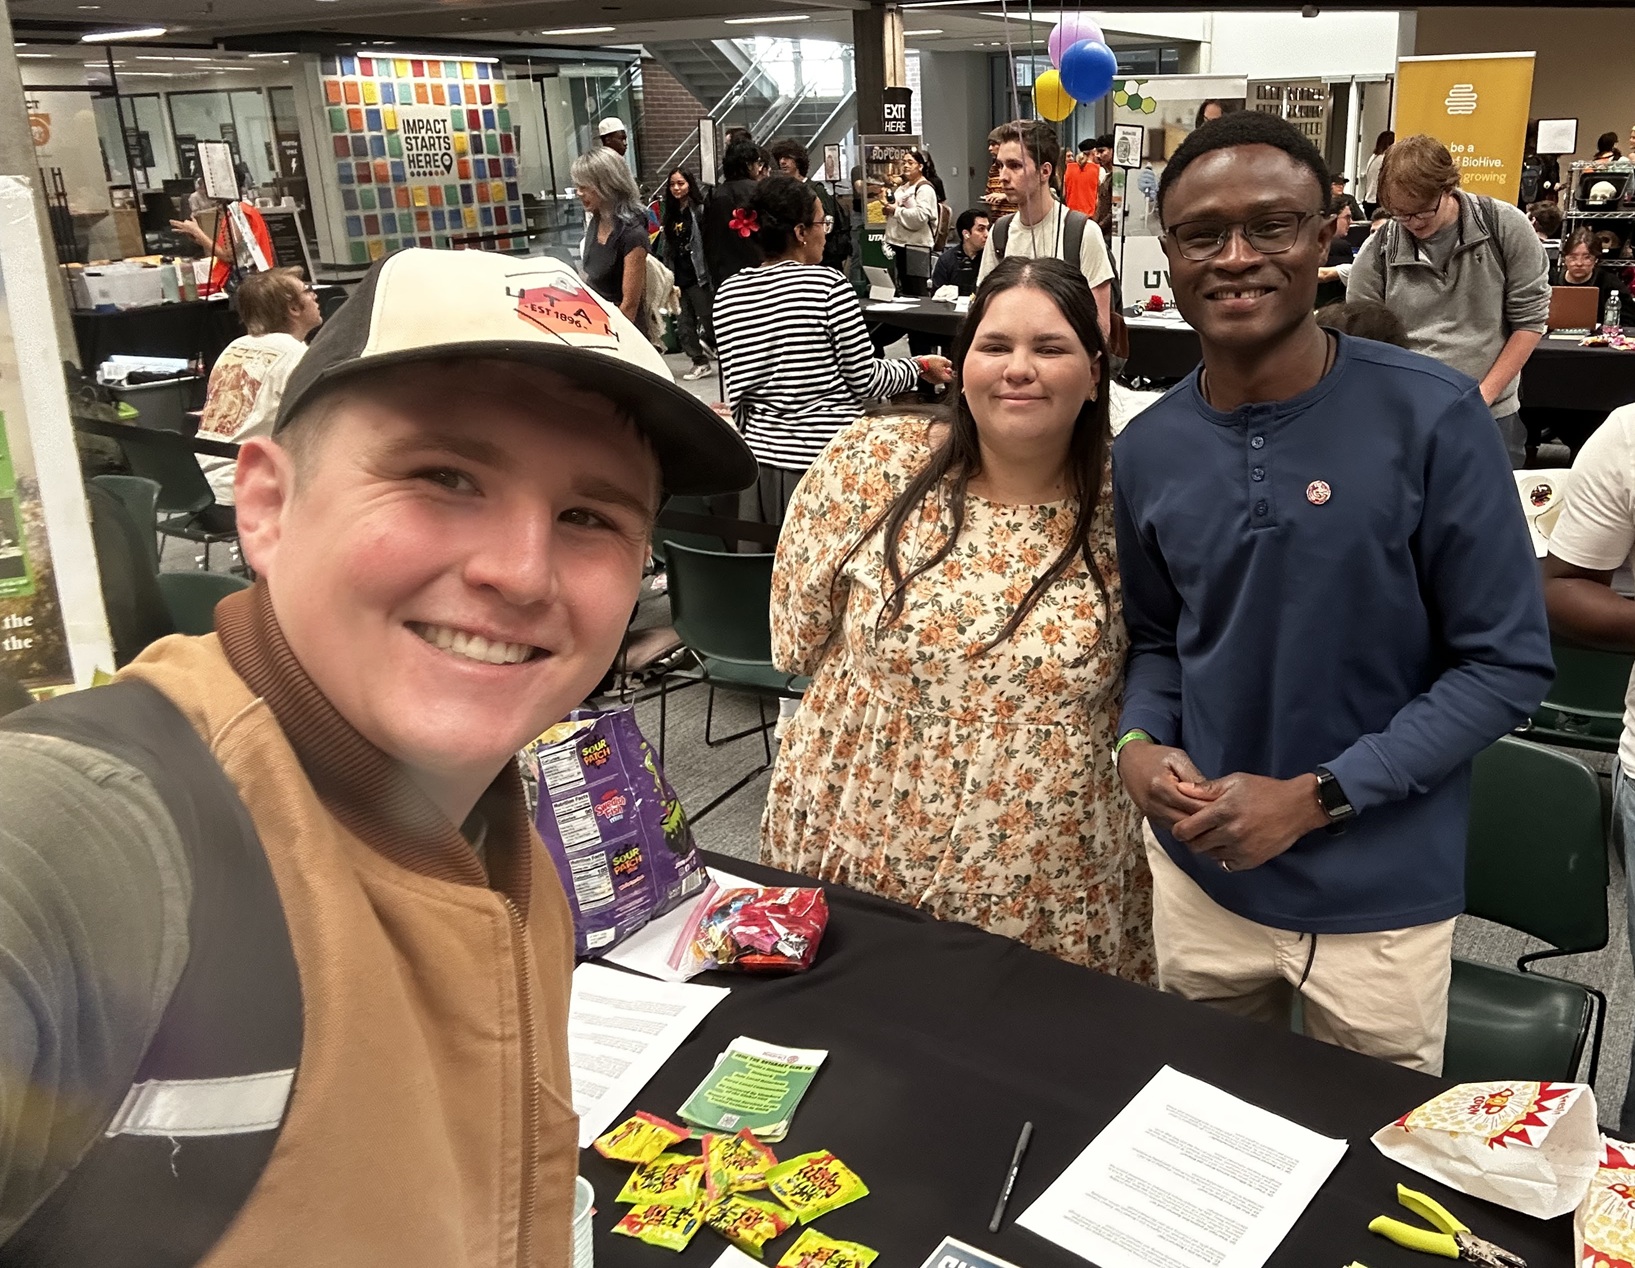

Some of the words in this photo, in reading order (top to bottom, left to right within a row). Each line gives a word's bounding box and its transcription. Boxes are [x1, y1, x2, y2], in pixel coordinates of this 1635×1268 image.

[884, 104, 906, 118] EXIT
[402, 119, 447, 134] IMPACT
[884, 121, 906, 132] HERE
[405, 136, 451, 151] STARTS
[1451, 142, 1464, 152] be
[407, 153, 441, 169] HERE
[872, 148, 909, 160] POPCOR
[1462, 157, 1504, 167] BioHive.
[1463, 171, 1507, 184] growing
[530, 303, 551, 316] EST
[554, 311, 582, 328] 1896
[4, 613, 34, 629] the
[3, 635, 33, 651] the
[582, 739, 607, 755] SOUR
[583, 747, 611, 766] PATCH
[594, 796, 627, 816] Swedish
[605, 807, 624, 819] Fish
[612, 847, 640, 866] SOUR
[613, 855, 643, 876] PATCH
[1467, 1096, 1486, 1115] CORN
[1482, 1088, 1515, 1115] POP
